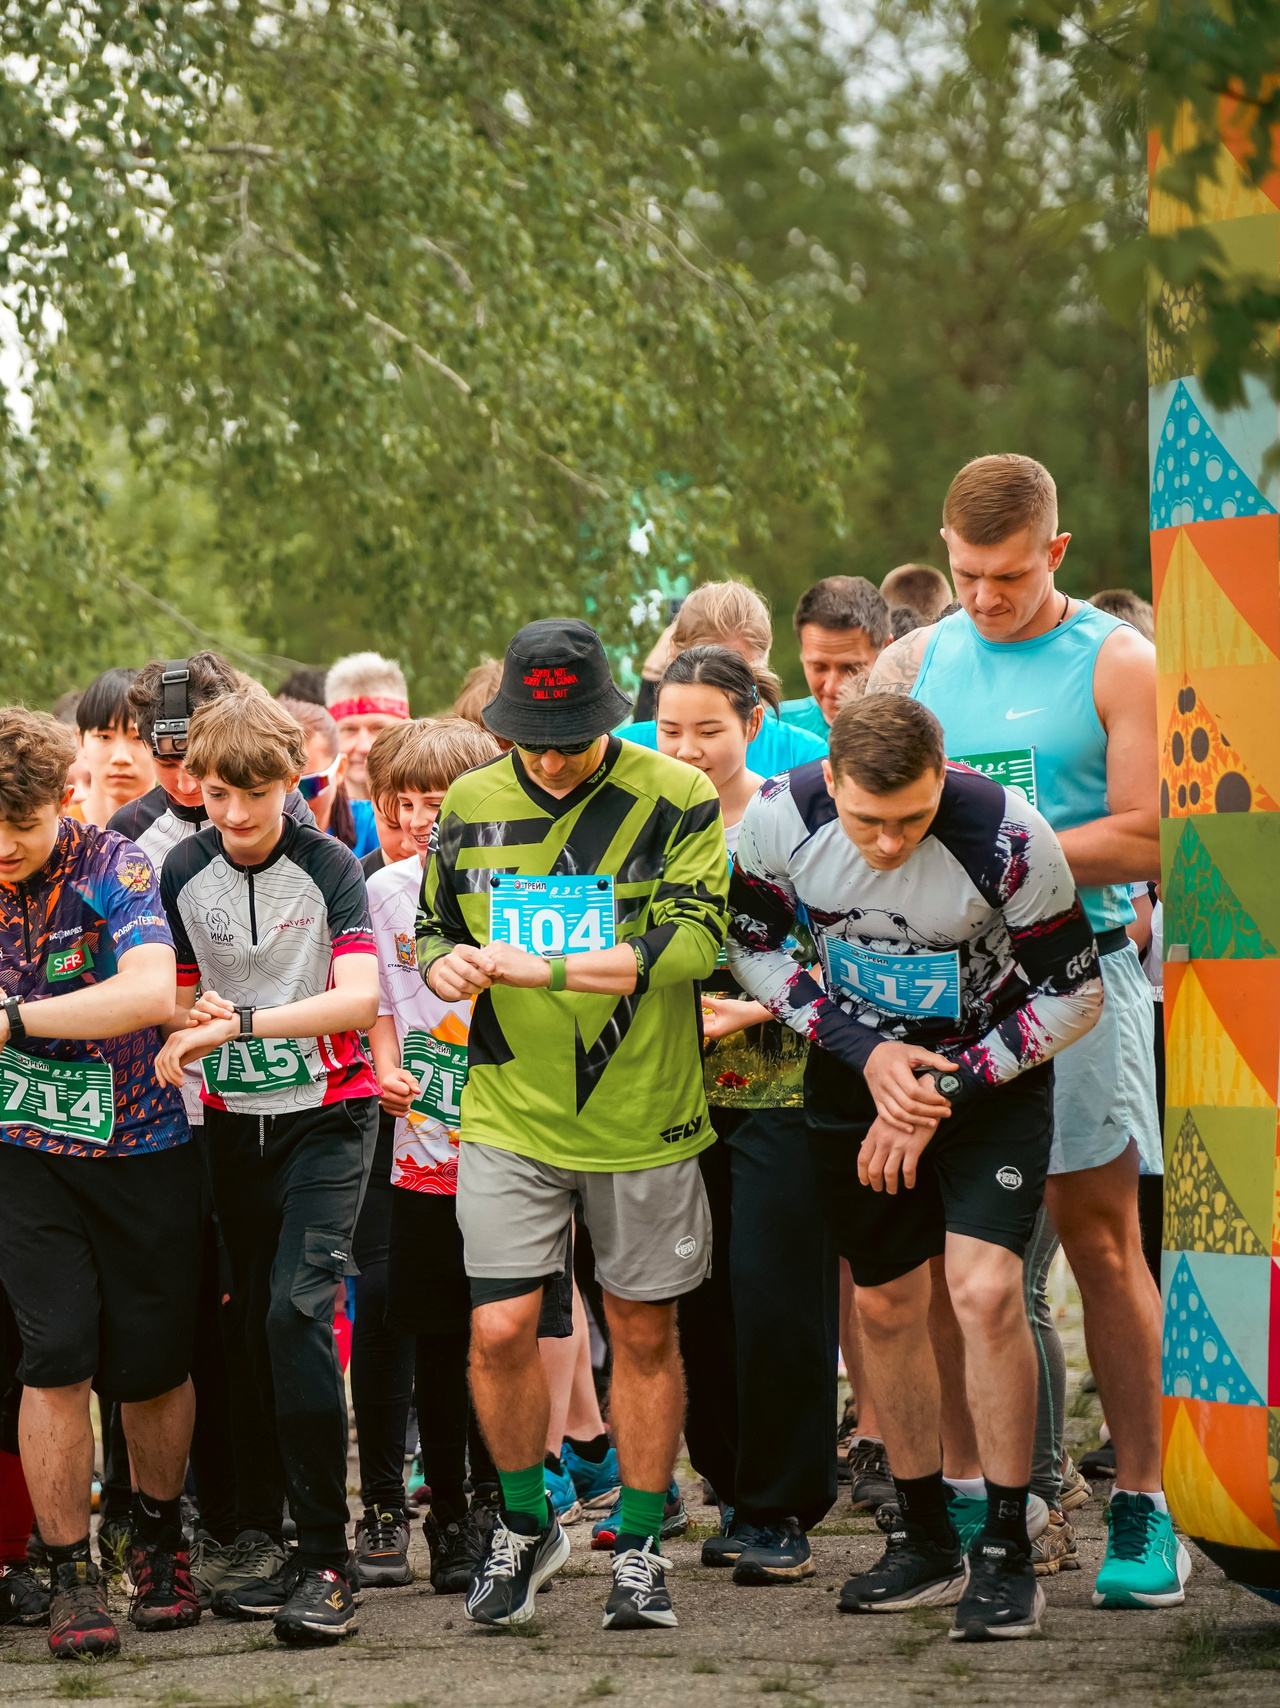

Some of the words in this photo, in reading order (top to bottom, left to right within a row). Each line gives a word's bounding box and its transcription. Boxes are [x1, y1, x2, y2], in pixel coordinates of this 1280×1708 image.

[523, 676, 540, 686] SORRY
[556, 674, 578, 686] GONNA
[532, 668, 551, 678] SORRY
[554, 667, 568, 677] NOT
[532, 690, 551, 699] CHILL
[553, 688, 569, 698] OUT
[210, 931, 234, 942] ИКАР
[503, 908, 606, 957] 104
[53, 953, 83, 972] SFR
[840, 957, 948, 1009] 117
[216, 1038, 300, 1083] 715
[3, 1069, 106, 1128] 714
[410, 1060, 460, 1117] 71
[658, 1114, 703, 1144] FLY
[982, 1546, 1007, 1556] HOKA
